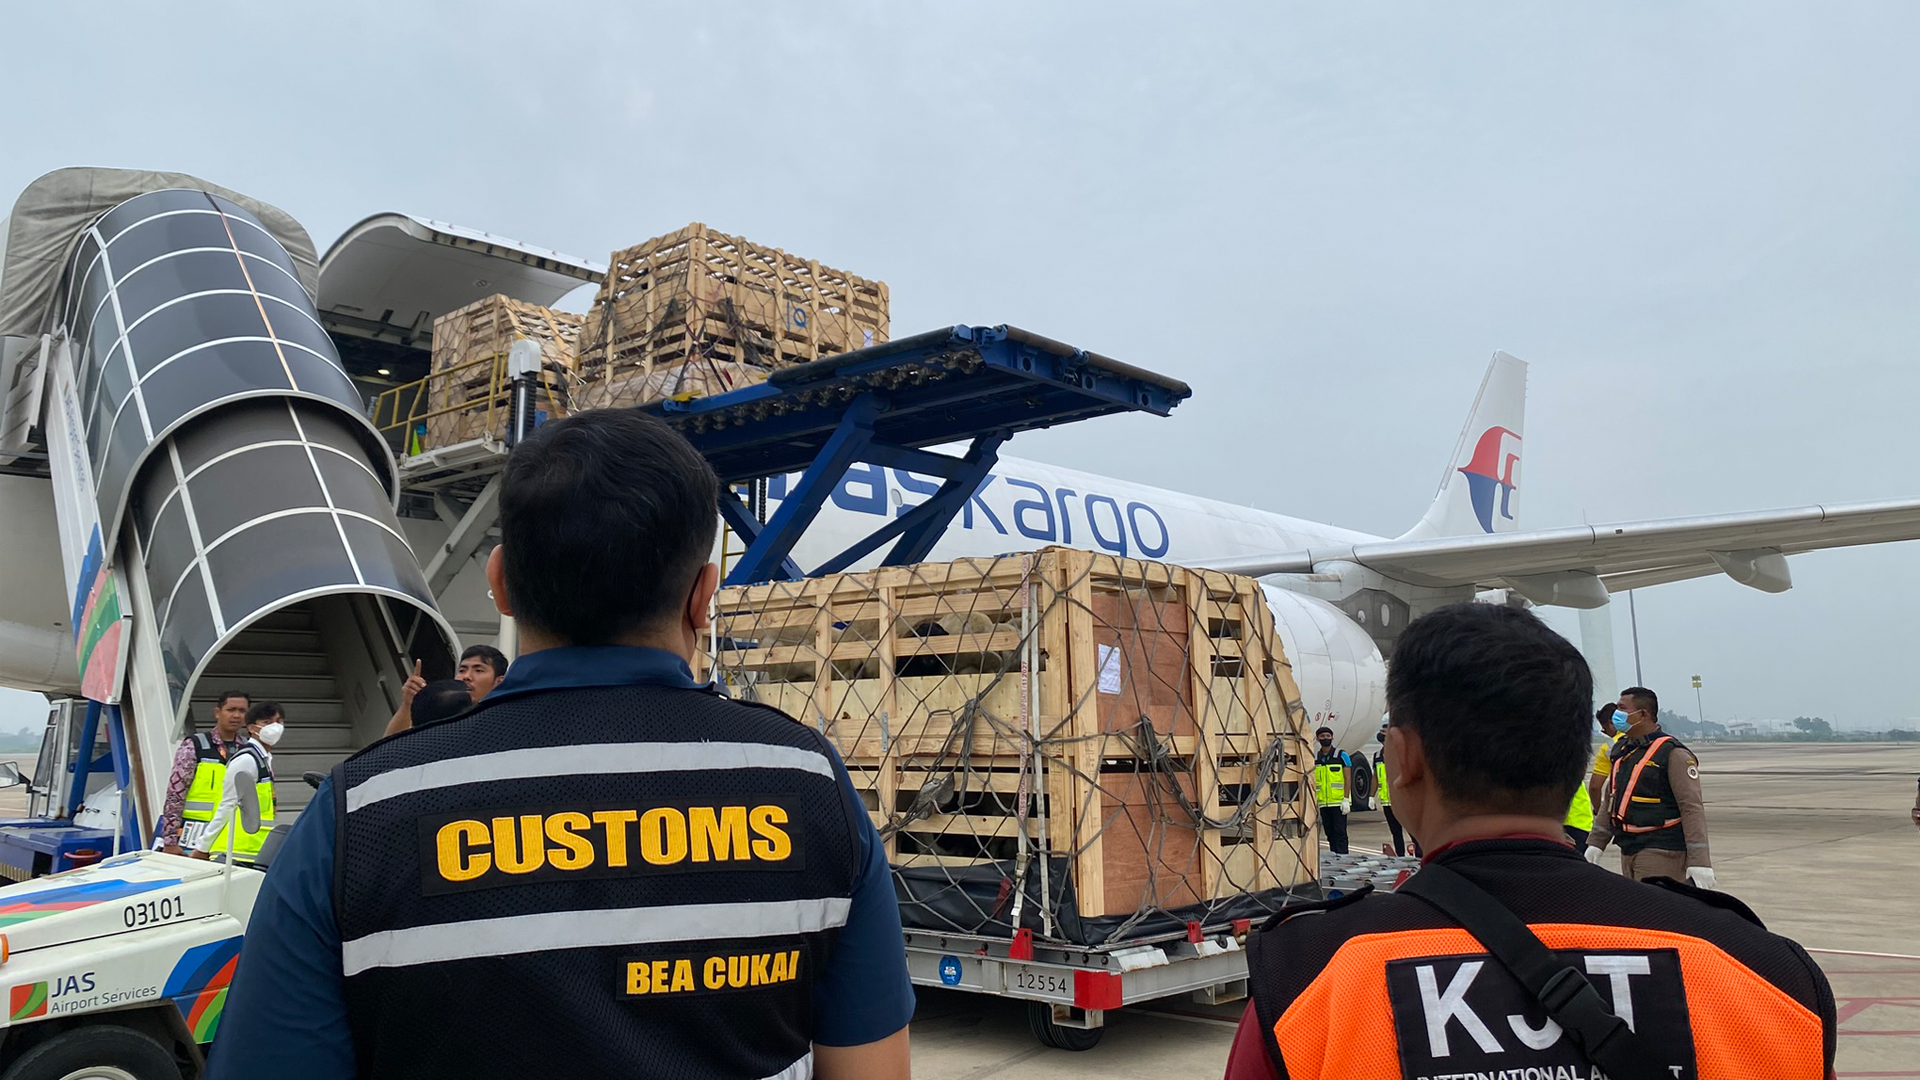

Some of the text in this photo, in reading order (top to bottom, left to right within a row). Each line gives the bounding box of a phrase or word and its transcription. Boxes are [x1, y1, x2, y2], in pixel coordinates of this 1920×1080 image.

[436, 805, 792, 881] CUSTOMS
[124, 895, 185, 928] 03101
[51, 972, 96, 998] JAS
[626, 950, 800, 995] BEA CUKAI
[1017, 973, 1067, 994] 12554
[51, 985, 157, 1014] Airport Services
